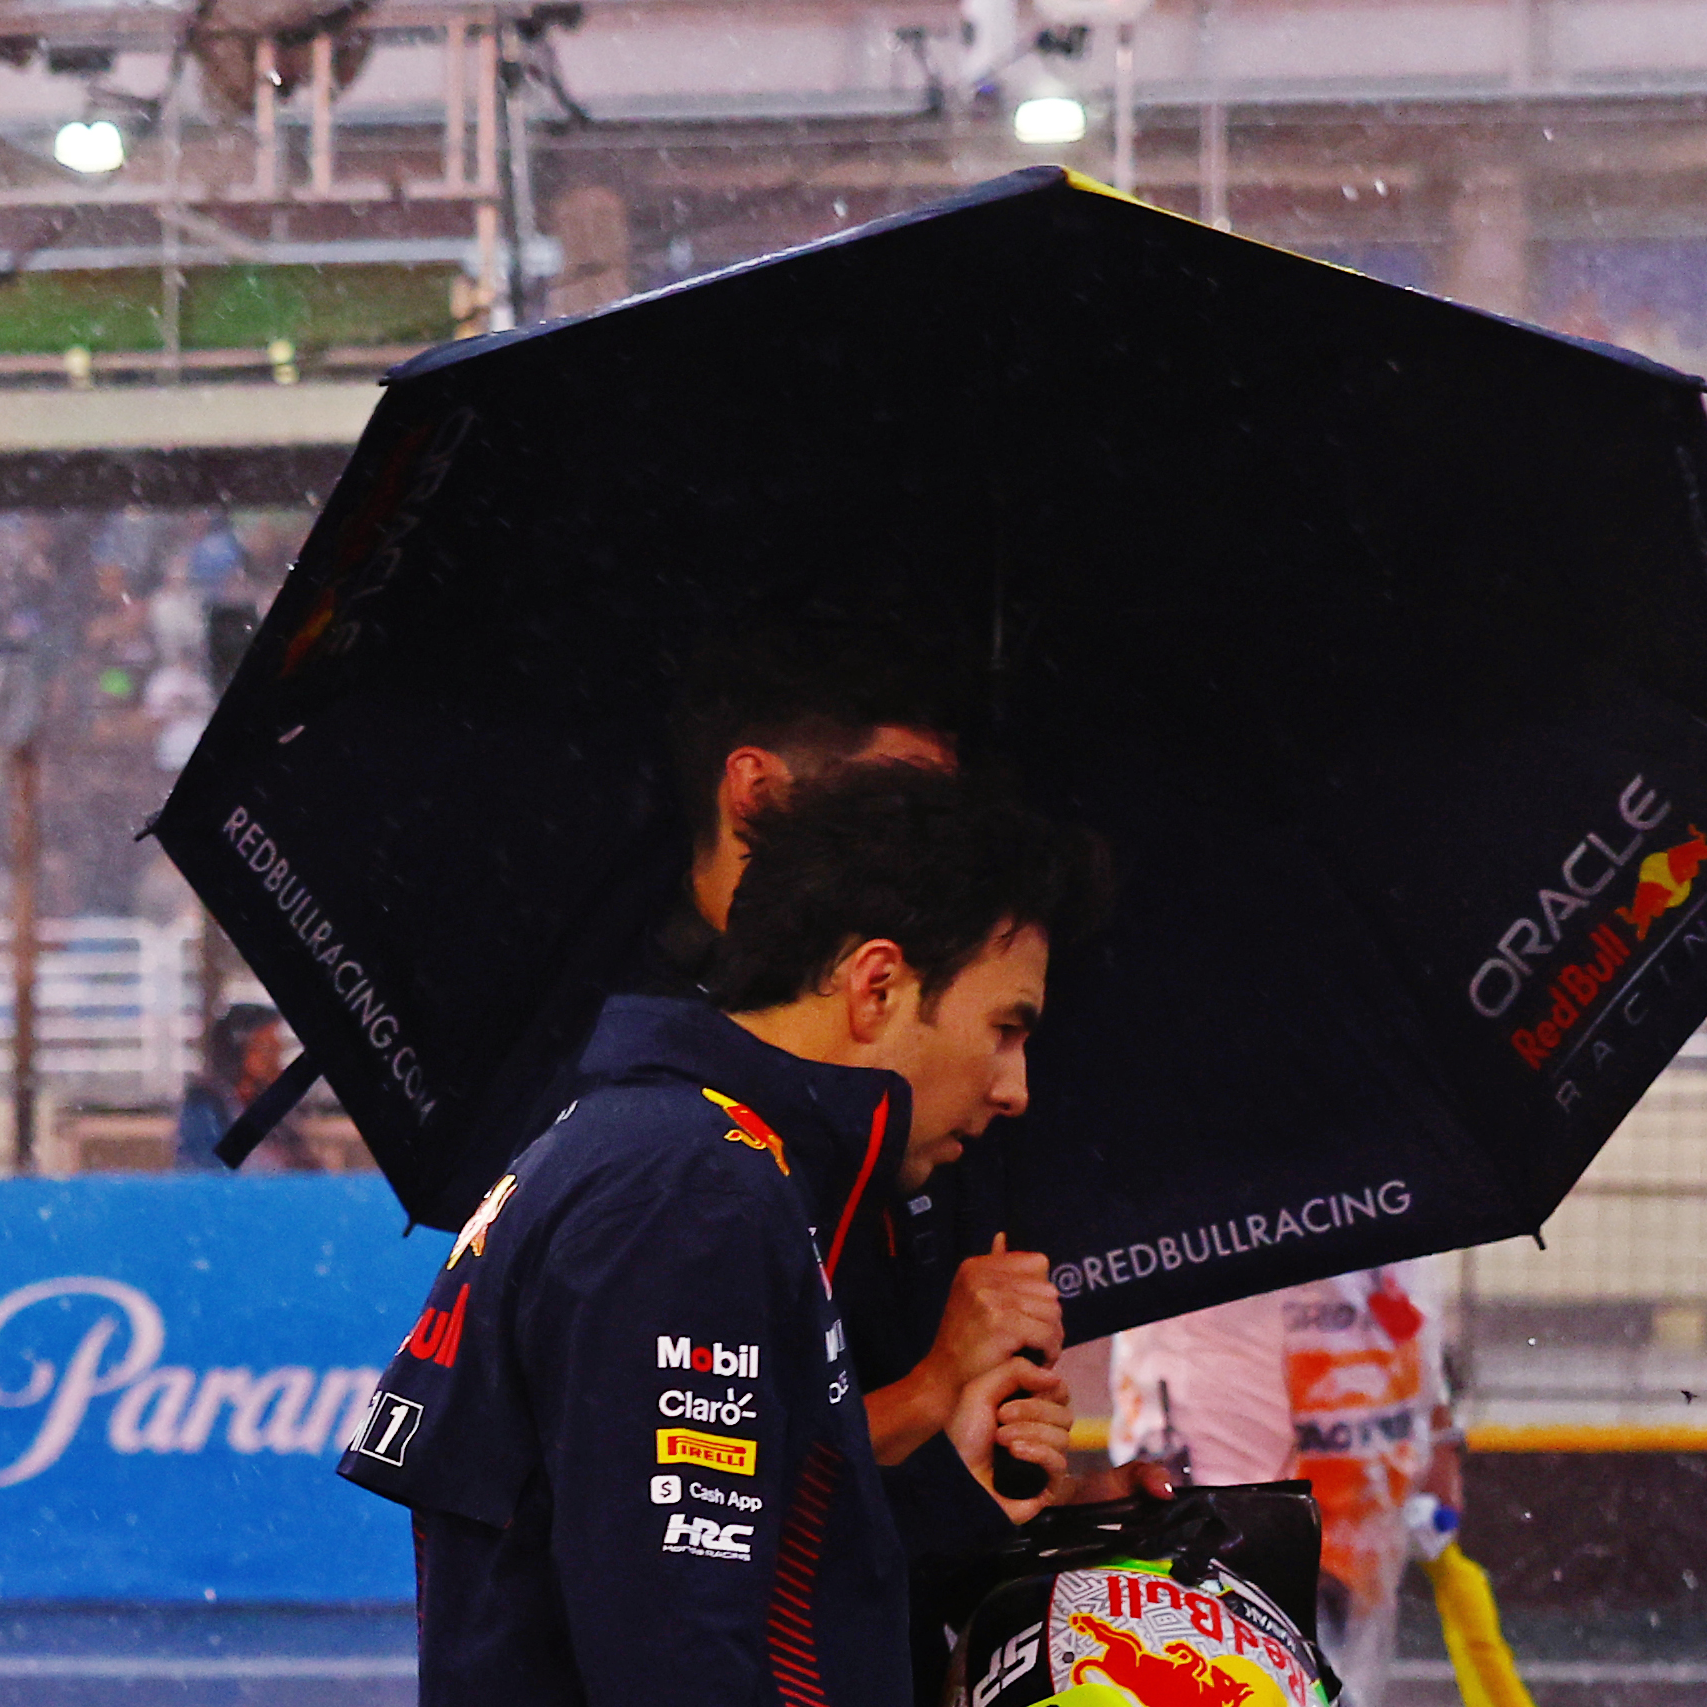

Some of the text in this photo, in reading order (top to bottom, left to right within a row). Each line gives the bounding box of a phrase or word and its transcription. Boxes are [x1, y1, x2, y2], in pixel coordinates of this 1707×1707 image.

[1469, 774, 1671, 1018] ORACLE
[1511, 923, 1631, 1071] Red Bull
[1049, 1179, 1413, 1299] @REDBULLRACING
[396, 1282, 472, 1369] ull
[656, 1335, 760, 1379] Mobil
[658, 1388, 755, 1426] Claro
[667, 1435, 747, 1467] PIRELLI
[689, 1481, 725, 1506] Cash
[726, 1490, 763, 1513] App
[663, 1513, 755, 1554] HRC
[1106, 1575, 1224, 1642] Bull
[1226, 1611, 1307, 1707] Red
